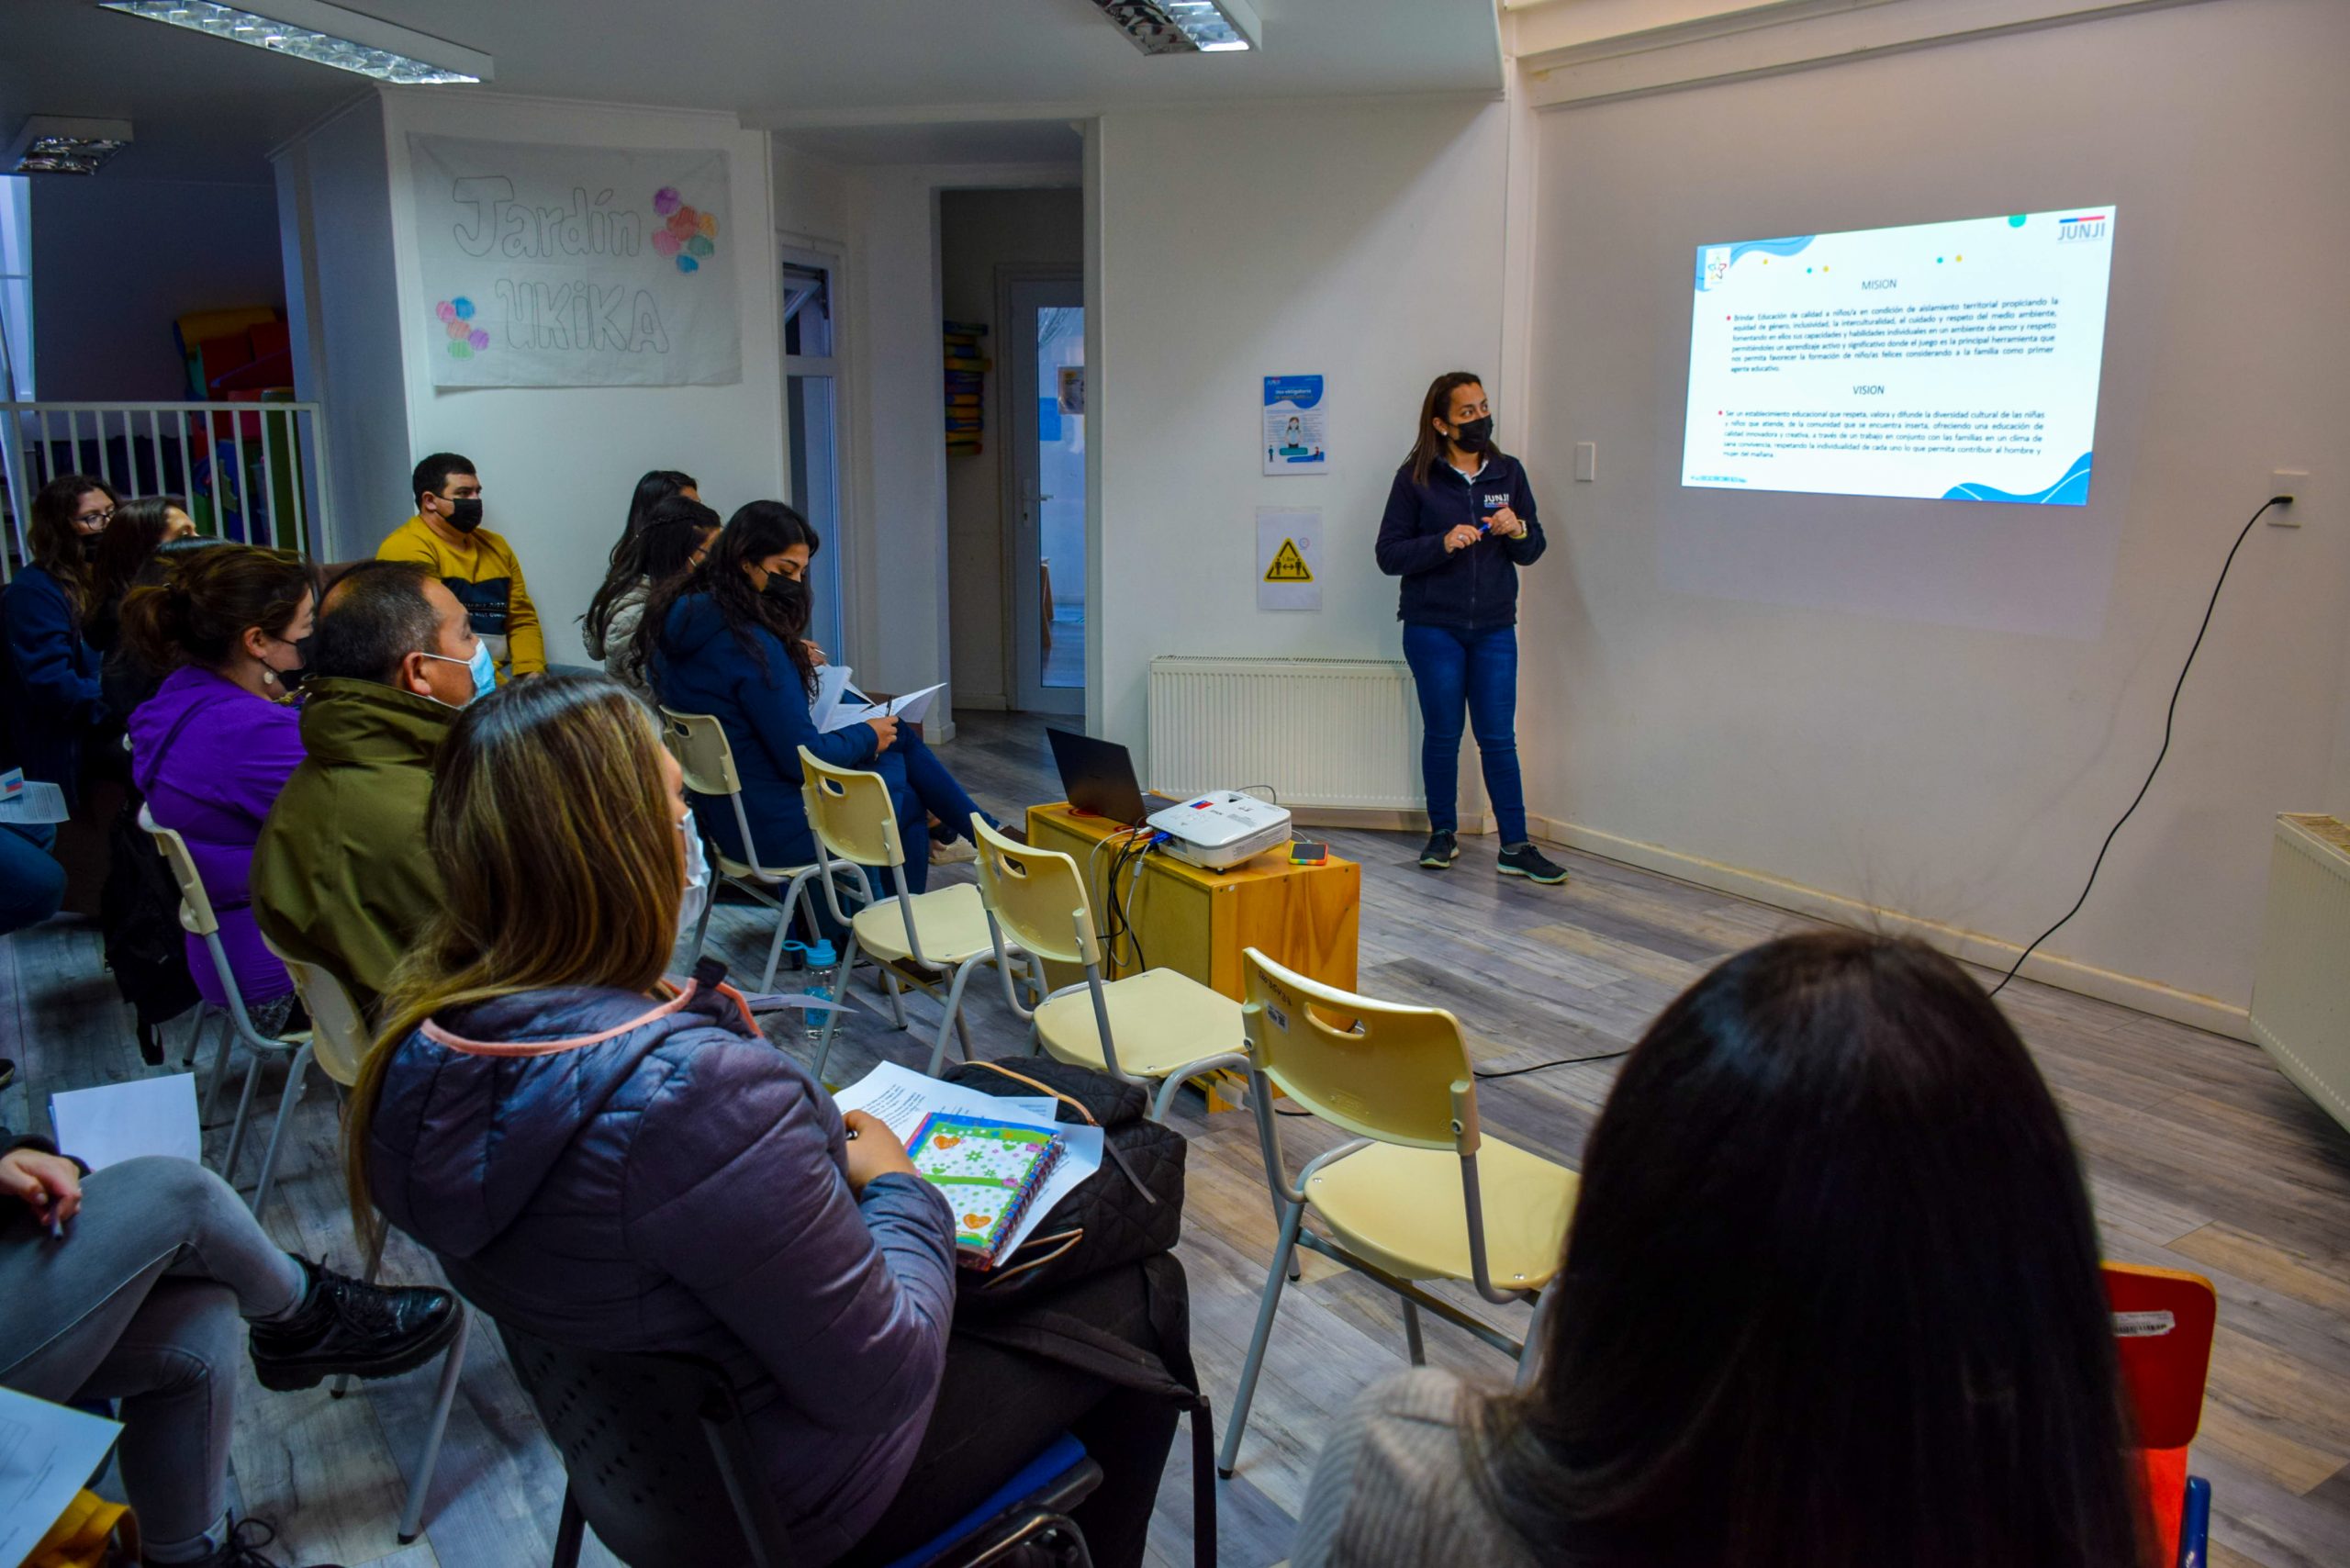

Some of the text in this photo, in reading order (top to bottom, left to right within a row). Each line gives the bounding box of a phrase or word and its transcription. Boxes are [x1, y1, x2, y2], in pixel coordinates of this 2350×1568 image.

[453, 175, 642, 258] Jardín
[2057, 222, 2106, 241] JUNJI
[1862, 278, 1897, 290] MISION
[1733, 313, 1755, 322] Brindar
[1757, 311, 1787, 320] Educación
[1801, 309, 1823, 319] calidad
[1871, 305, 1904, 314] condición
[1919, 301, 1960, 311] aislamiento
[1963, 299, 1998, 309] territorial
[2001, 297, 2047, 309] propiciando
[1733, 323, 1757, 334] equidad
[1908, 314, 1936, 323] cuidado
[1946, 313, 1974, 324] respeto
[1976, 312, 1988, 320] del
[1991, 311, 2015, 319] medio
[1732, 332, 1768, 341] fomentando
[1777, 331, 1792, 340] ellos
[1805, 330, 1841, 341] capacidades
[1849, 328, 1886, 337] habilidades
[1887, 326, 1927, 335] individuales
[1951, 324, 1985, 333] ambiente
[2026, 321, 2056, 332] respeto
[1731, 342, 1775, 354] permitiéndoles
[1785, 342, 1820, 353] aprendizaje
[1821, 341, 1841, 349] activo
[1848, 339, 1886, 351] significativo
[1887, 338, 1909, 347] donde
[1919, 338, 1938, 348] juego
[1958, 336, 1990, 347] principal
[1991, 334, 2038, 343] herramienta
[2040, 336, 2056, 344] que
[1744, 353, 1767, 364] permita
[1769, 352, 1797, 361] favorecer
[1808, 351, 1841, 359] formación
[1882, 349, 1903, 357] felices
[1906, 348, 1953, 357] considerando
[1974, 346, 1999, 355] familia
[2027, 345, 2054, 356] primer
[1730, 365, 1750, 375] agente
[1852, 385, 1886, 395] VISION
[1744, 409, 1790, 418] establecimiento
[1792, 409, 1829, 418] educacional
[1870, 409, 1890, 418] valora
[1897, 409, 1923, 418] difunde
[1748, 421, 1760, 430] que
[1807, 420, 1841, 428] comunidad
[1843, 422, 1856, 431] que
[1868, 420, 1902, 429] encuentra
[1933, 420, 1972, 429] ofreciendo
[1992, 421, 2031, 430] educación
[1745, 430, 1778, 438] innovadora
[1860, 431, 1884, 442] trabajo
[1896, 432, 1926, 442] conjunto
[1942, 432, 1953, 441] las
[1954, 432, 1983, 441] familias
[2009, 433, 2031, 442] clima
[1817, 442, 1860, 450] individualidad
[1873, 442, 1887, 451] cada
[1928, 444, 1955, 454] permita
[1957, 444, 1992, 453] contribuir
[2004, 445, 2034, 454] hombre
[1483, 493, 1510, 503] JUNJI
